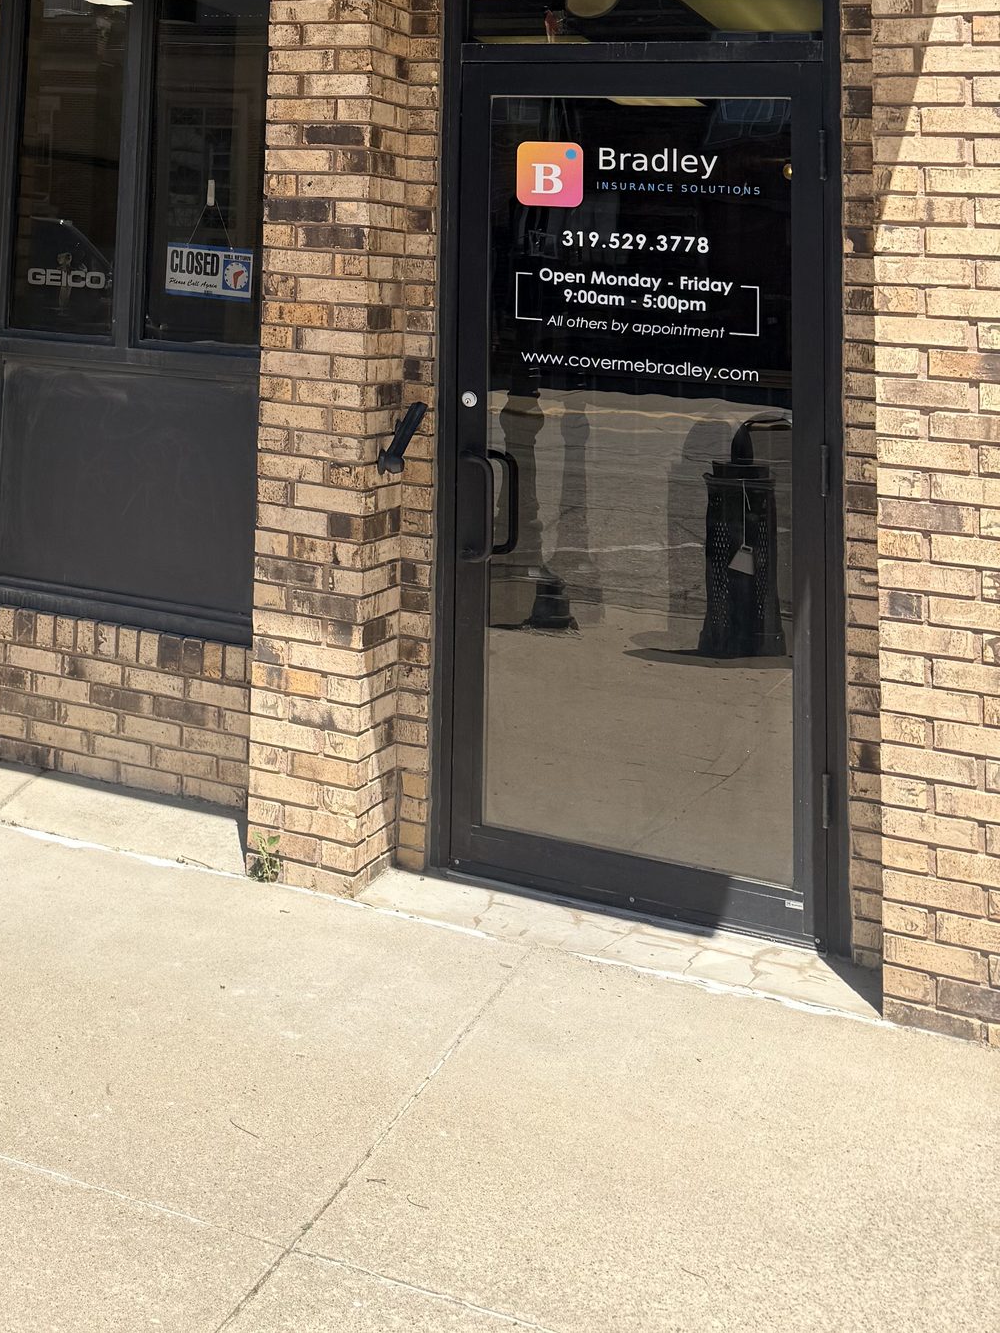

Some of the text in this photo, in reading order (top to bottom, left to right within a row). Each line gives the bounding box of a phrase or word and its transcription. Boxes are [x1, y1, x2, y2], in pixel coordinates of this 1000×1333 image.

[598, 147, 718, 180] Bradley
[530, 162, 564, 195] B
[596, 181, 761, 196] INSURANCE SOLUTIONS
[561, 230, 710, 254] 319.529.3778
[170, 249, 220, 277] CLOSED
[27, 267, 106, 290] GEICO
[186, 278, 200, 287] Call
[200, 280, 218, 289] Again
[539, 267, 586, 285] Open
[590, 270, 662, 292] Monday
[680, 275, 734, 296] Friday
[563, 288, 625, 307] 9:00am
[642, 293, 707, 314] 5:00pm
[546, 315, 726, 339] All others by appointment
[521, 351, 760, 382] www.covermebradley.com
